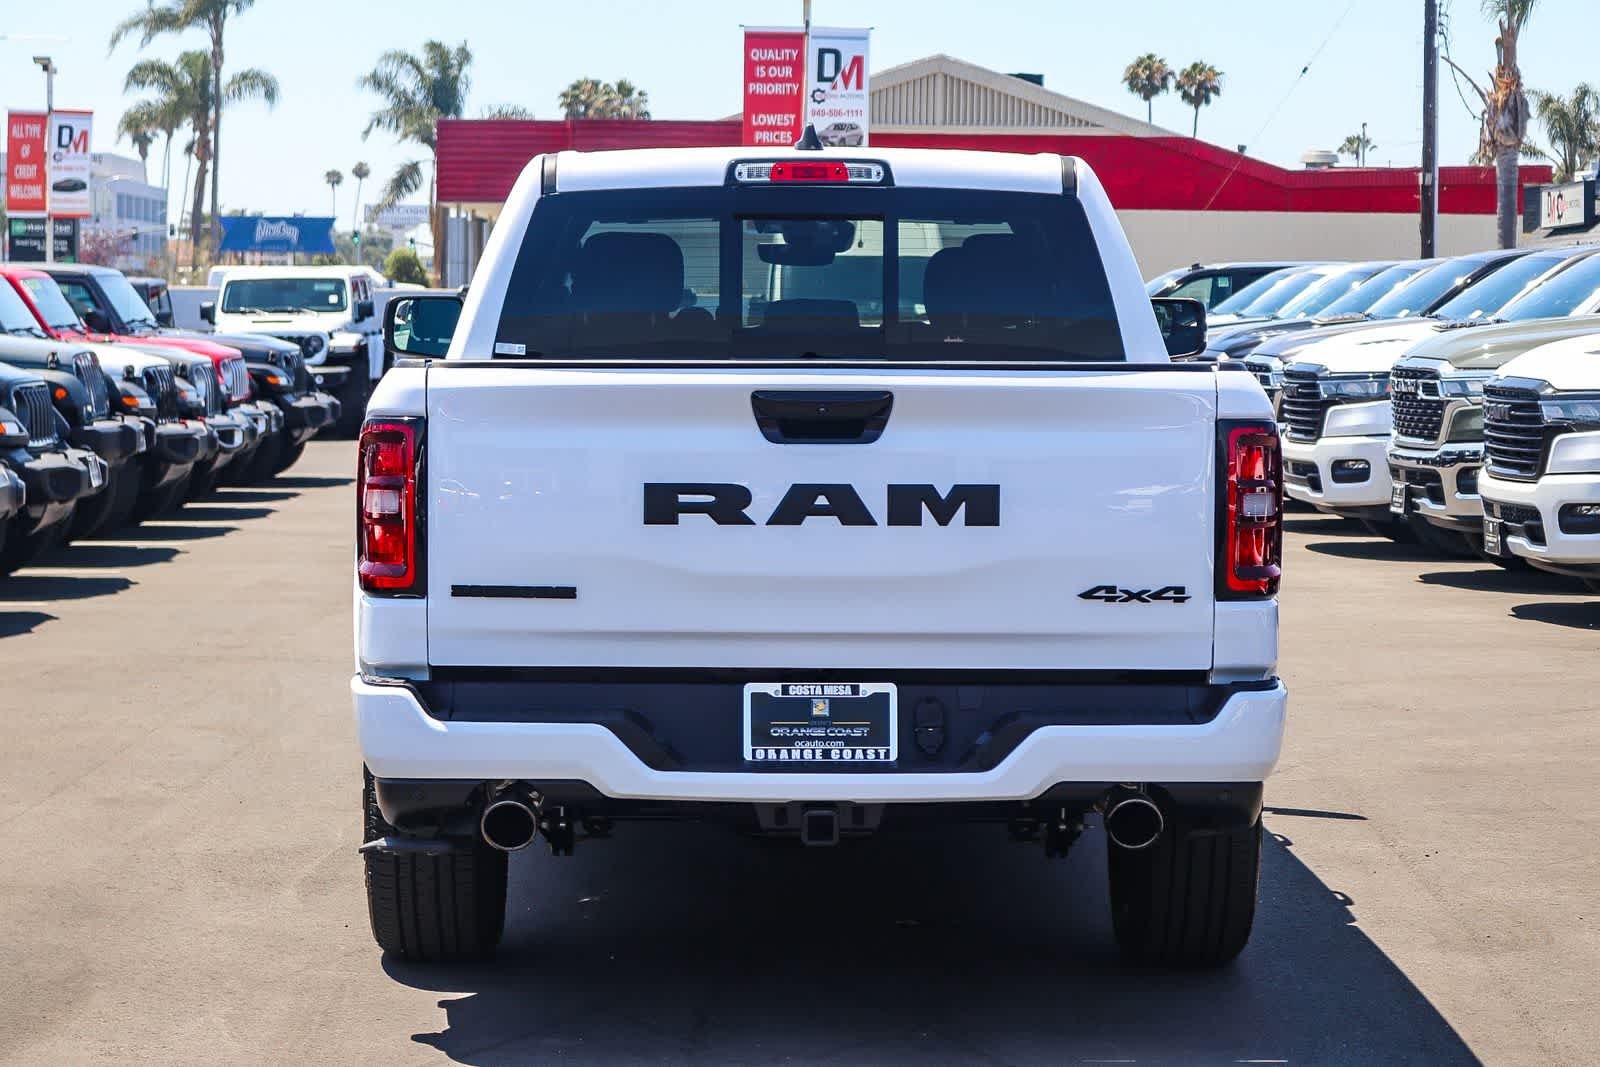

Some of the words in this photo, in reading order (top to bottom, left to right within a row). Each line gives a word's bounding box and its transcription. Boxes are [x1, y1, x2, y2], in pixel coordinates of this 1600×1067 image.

[751, 48, 798, 61] QUALITY
[756, 66, 766, 78] IS
[769, 66, 792, 78] OUR
[748, 83, 799, 95] PRIORITY
[752, 114, 795, 126] LOWEST
[12, 123, 24, 138] ALL
[755, 131, 792, 144] PRICES
[14, 164, 37, 179] CREDIT
[9, 183, 42, 200] WELCOME
[644, 483, 1000, 526] RAM
[1076, 585, 1192, 603] 4x4
[788, 685, 822, 695] COSTA
[823, 685, 852, 695] MESA
[770, 727, 826, 737] ORANGE
[827, 727, 869, 737] COAST
[794, 739, 845, 748] ocauto.com
[755, 749, 823, 760] ORANGE
[831, 749, 887, 760] COAST
